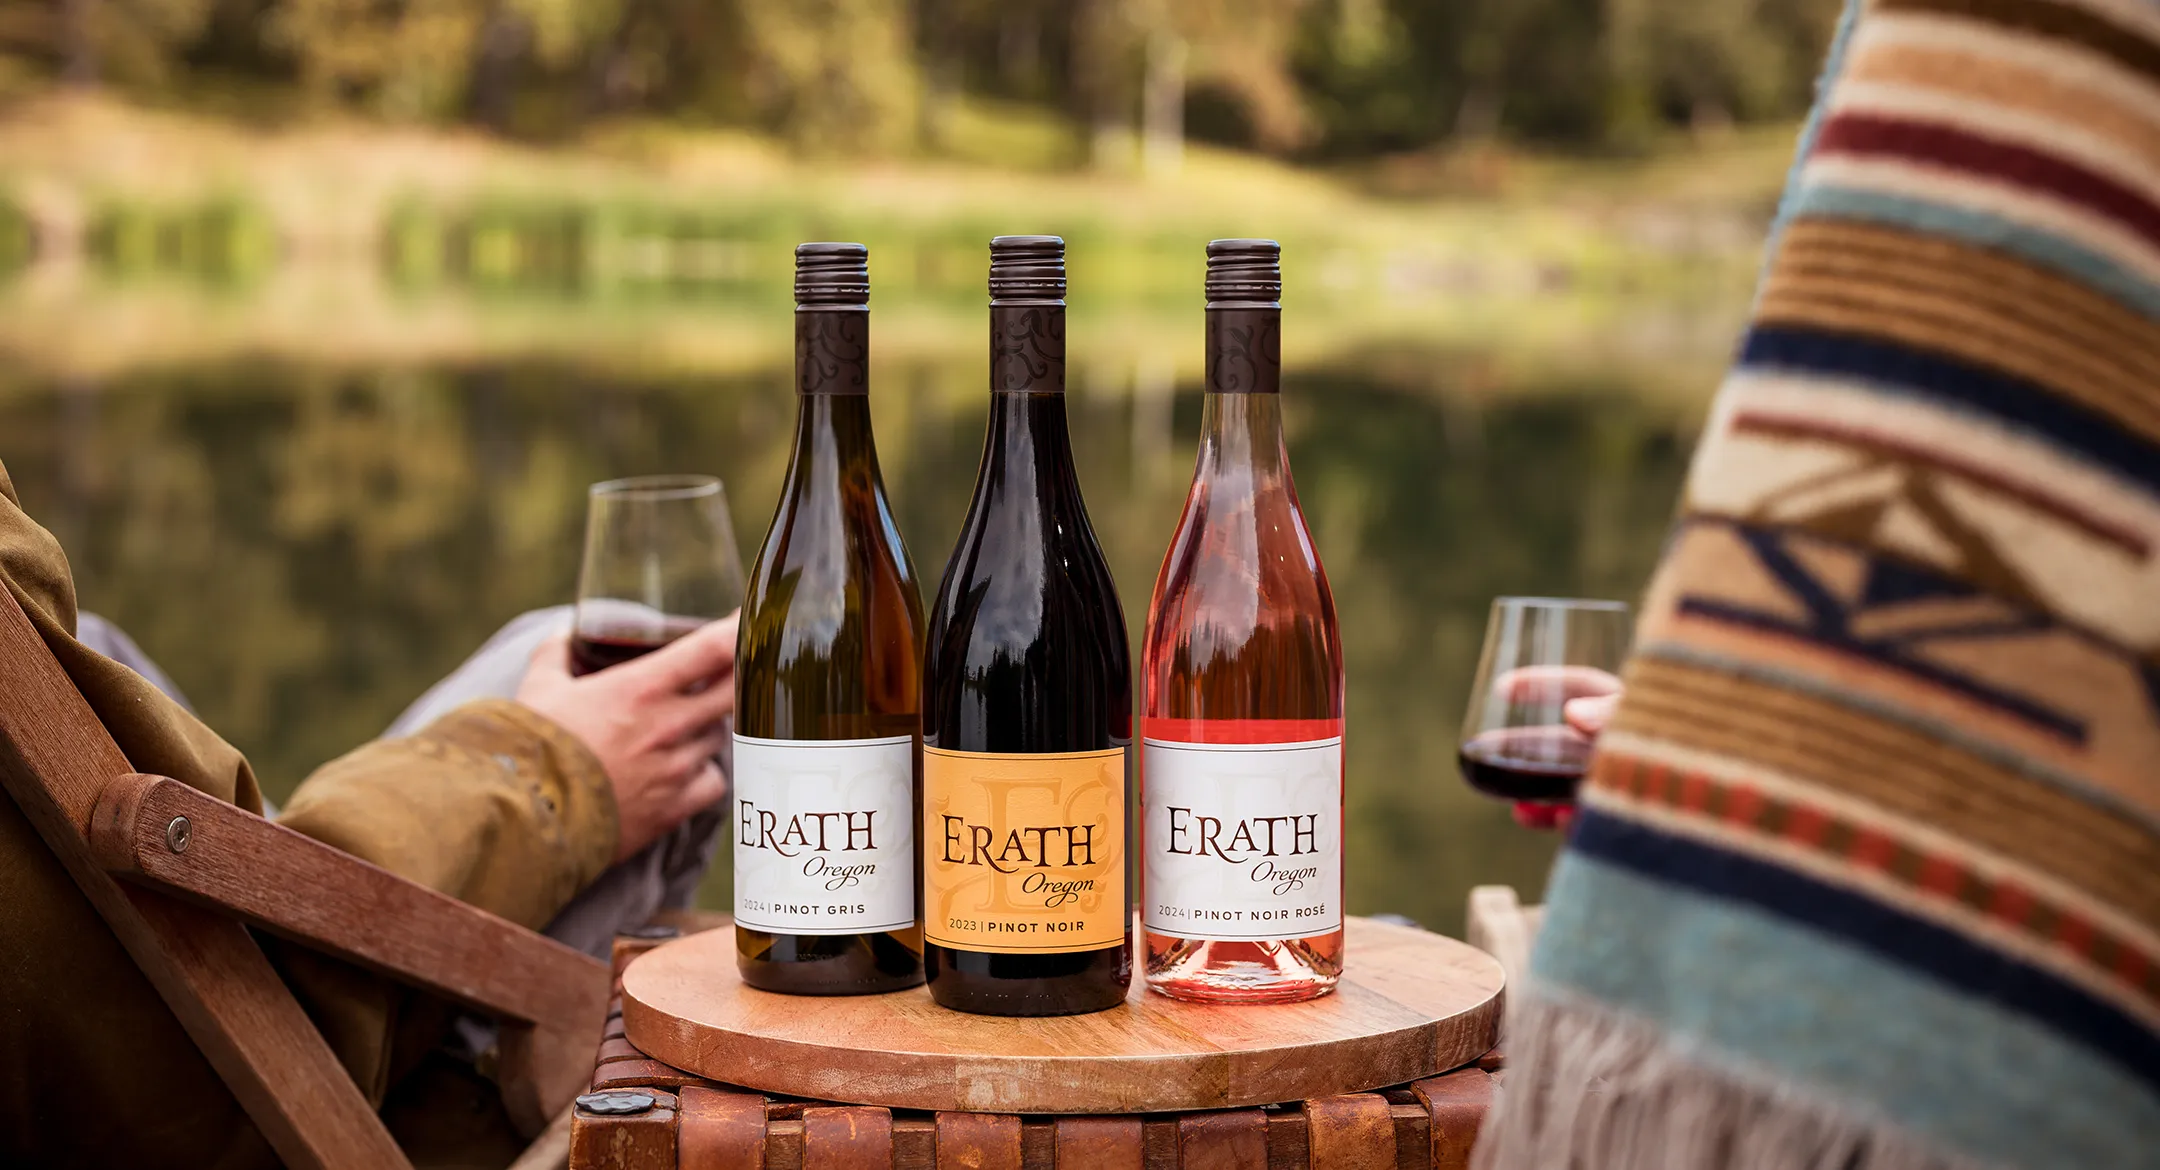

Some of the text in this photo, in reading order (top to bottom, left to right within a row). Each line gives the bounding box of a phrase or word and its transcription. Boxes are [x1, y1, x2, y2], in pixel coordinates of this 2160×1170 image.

[739, 799, 878, 857] ERATH
[941, 814, 1096, 873] ERATH
[1166, 806, 1319, 864] ERATH
[803, 856, 876, 891] Oregon
[1022, 872, 1094, 908] Oregon
[1250, 861, 1317, 895] Oregon
[744, 899, 865, 915] 2024 PINOT GRIS
[1159, 903, 1325, 921] 2024 PINOT NOIR ROSÉ
[949, 918, 1084, 933] 2023 PINOT NOIR
